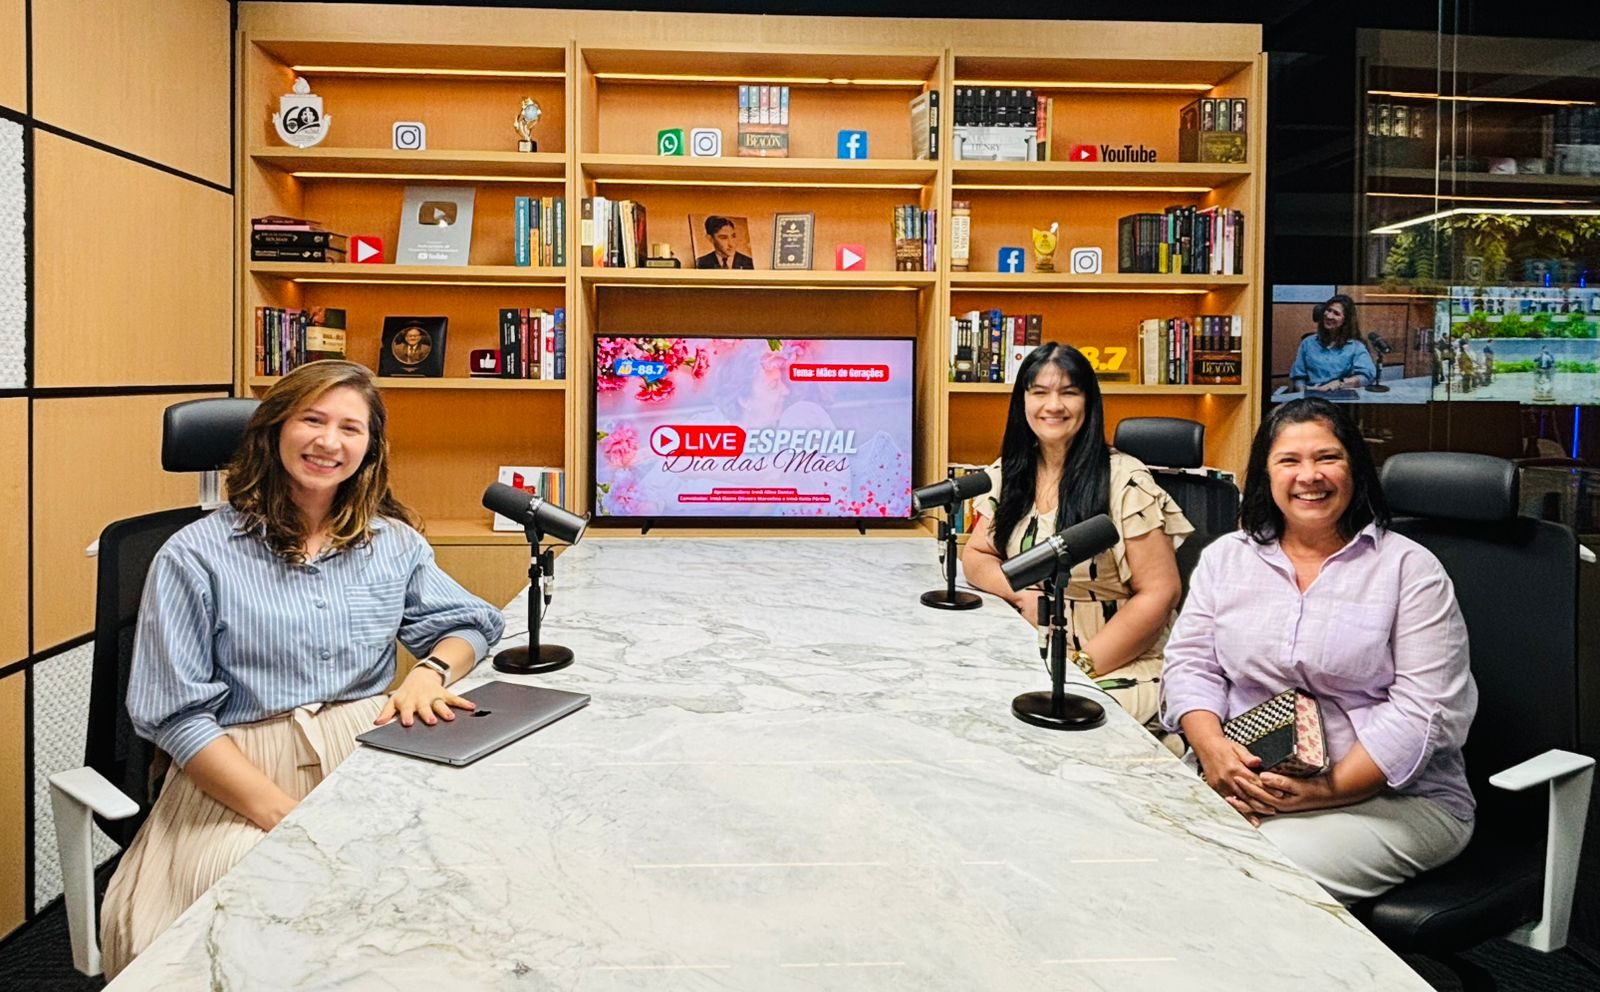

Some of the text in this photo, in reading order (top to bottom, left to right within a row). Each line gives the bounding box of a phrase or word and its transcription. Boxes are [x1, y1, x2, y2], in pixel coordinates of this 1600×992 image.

[1099, 144, 1157, 162] YouTube
[638, 364, 665, 375] 88.7
[793, 366, 885, 381] Tema: Mães de Gerações
[1202, 361, 1235, 374] BEACON
[685, 429, 858, 454] LIVE ESPECIAL
[662, 447, 850, 474] Dia das Mães
